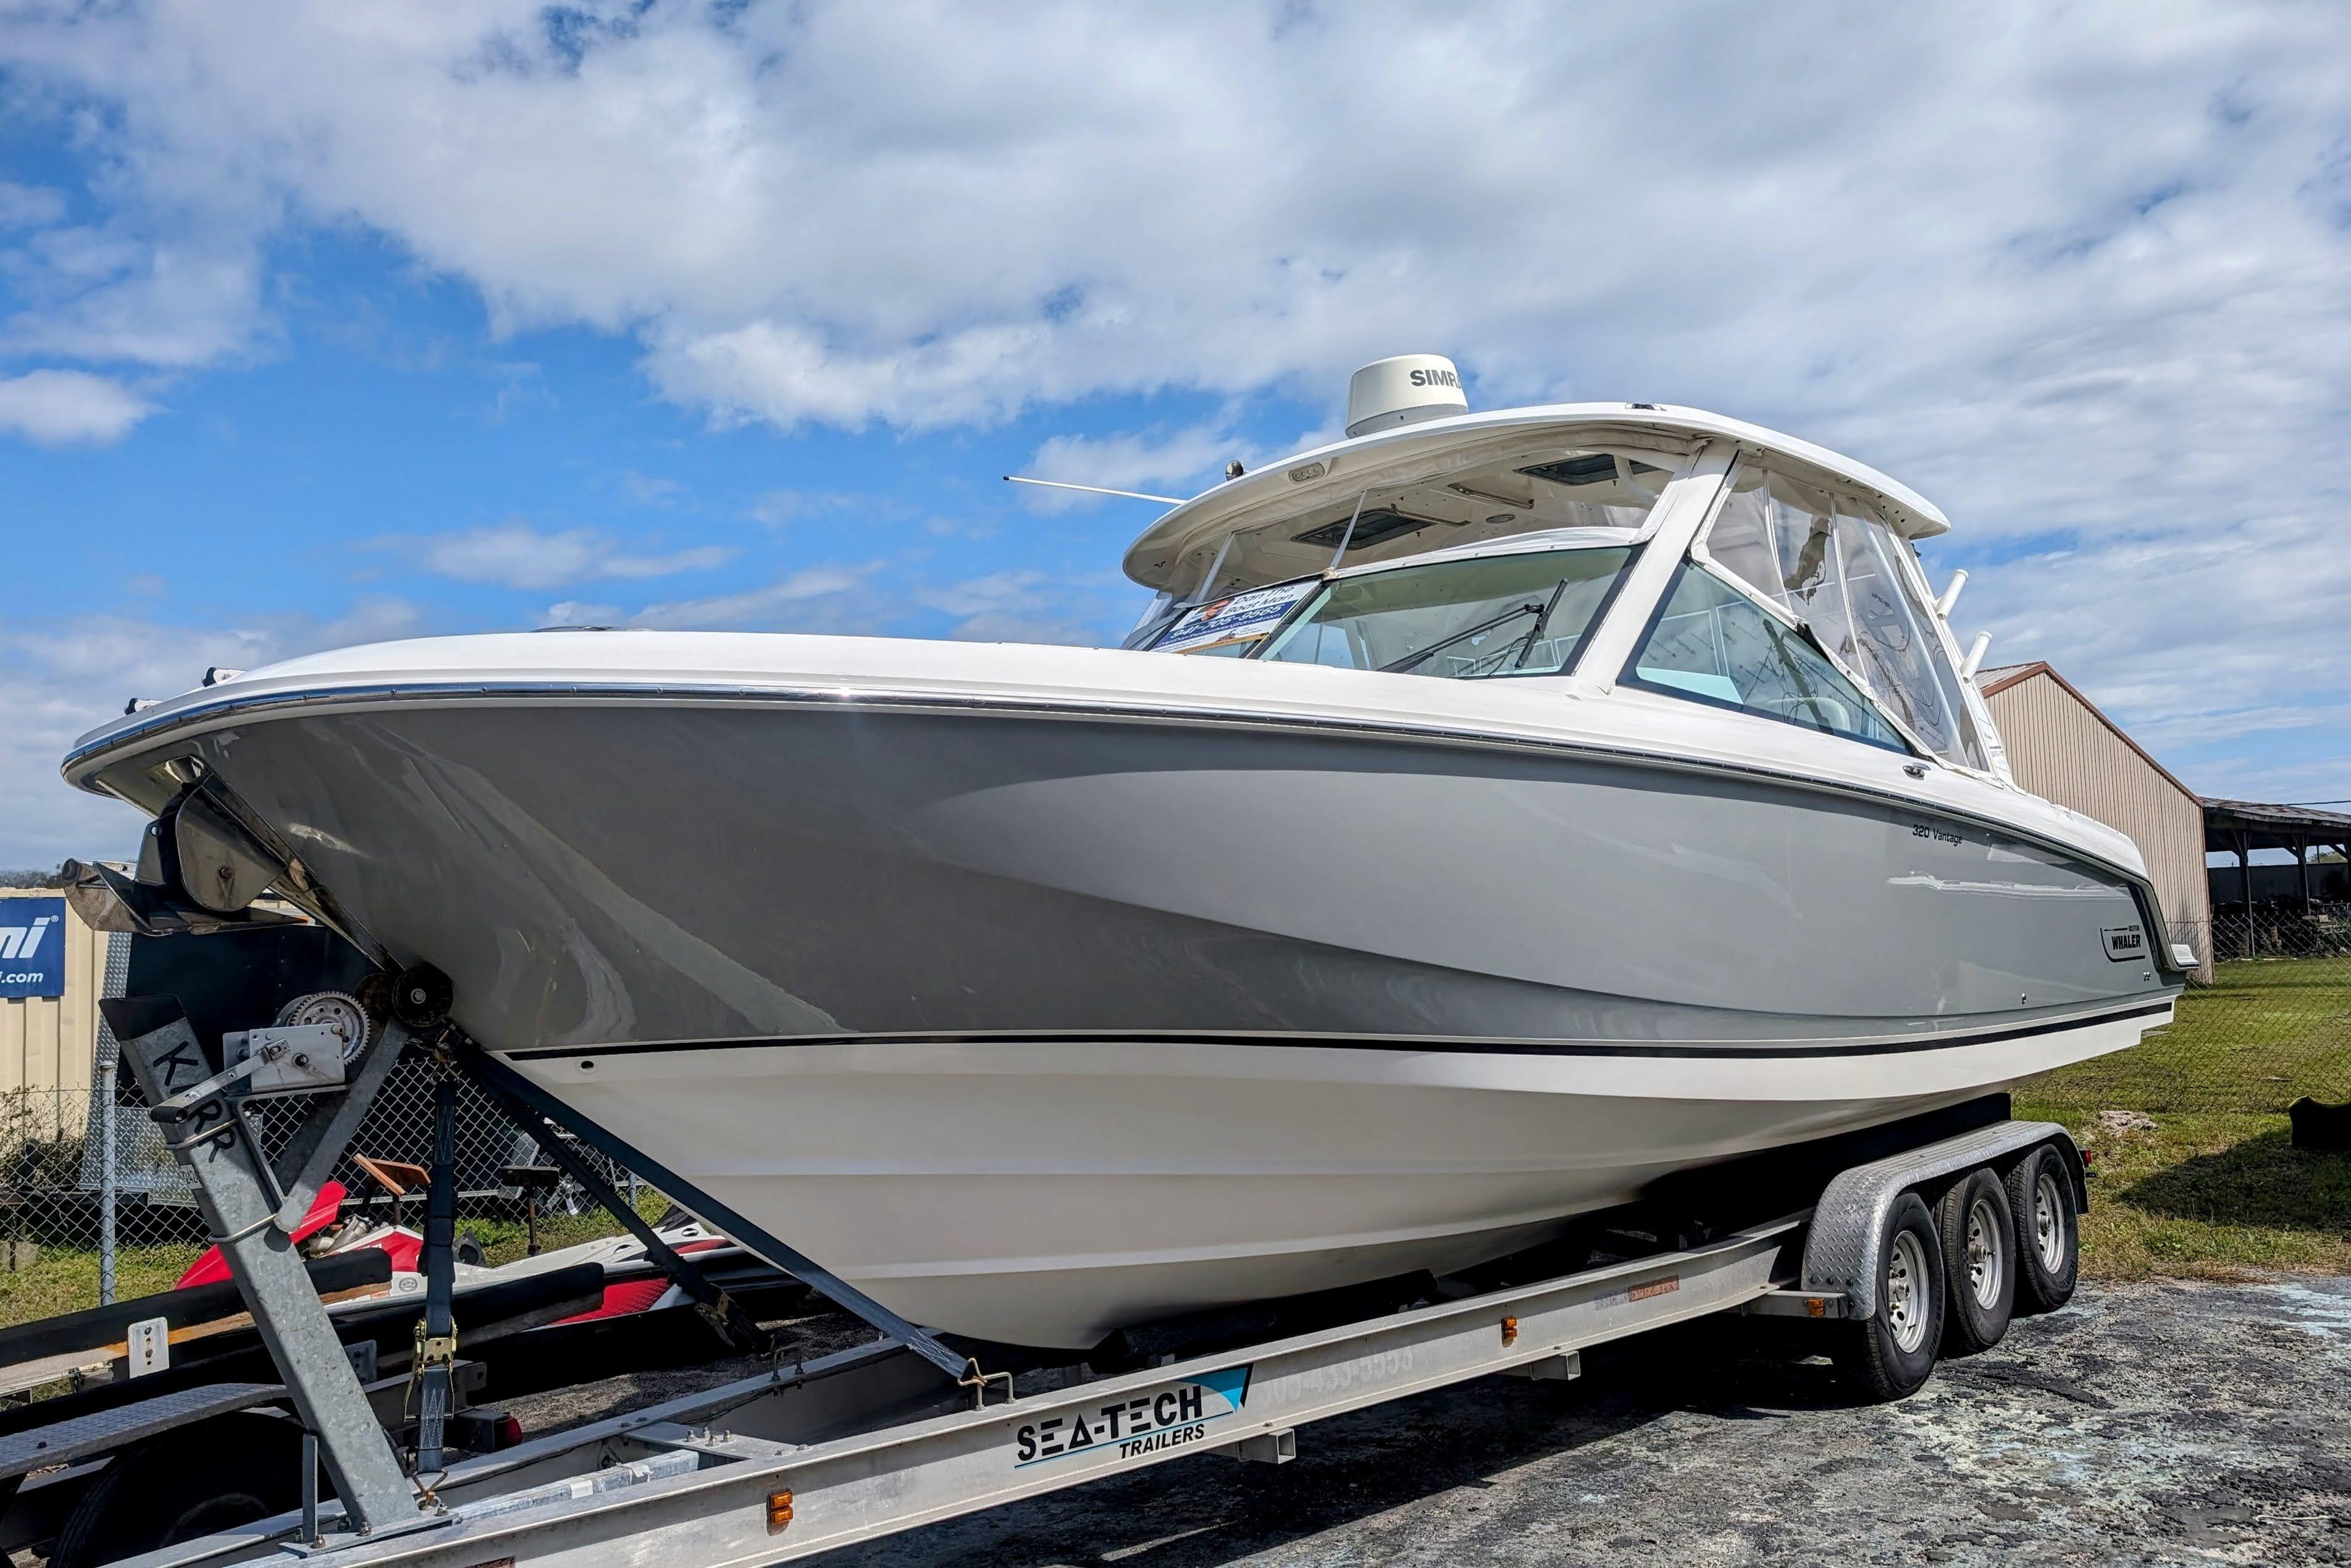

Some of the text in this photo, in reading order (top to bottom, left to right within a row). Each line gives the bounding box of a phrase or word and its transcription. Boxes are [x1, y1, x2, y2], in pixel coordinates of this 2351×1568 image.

[1223, 593, 1294, 615] Boat Man
[1234, 586, 1294, 605] Dan The
[1913, 824, 1963, 847] 320 Vantage
[2111, 934, 2141, 950] WHALER
[1017, 1386, 1202, 1461] SEA-TECH
[1120, 1423, 1205, 1459] TRAILERS
